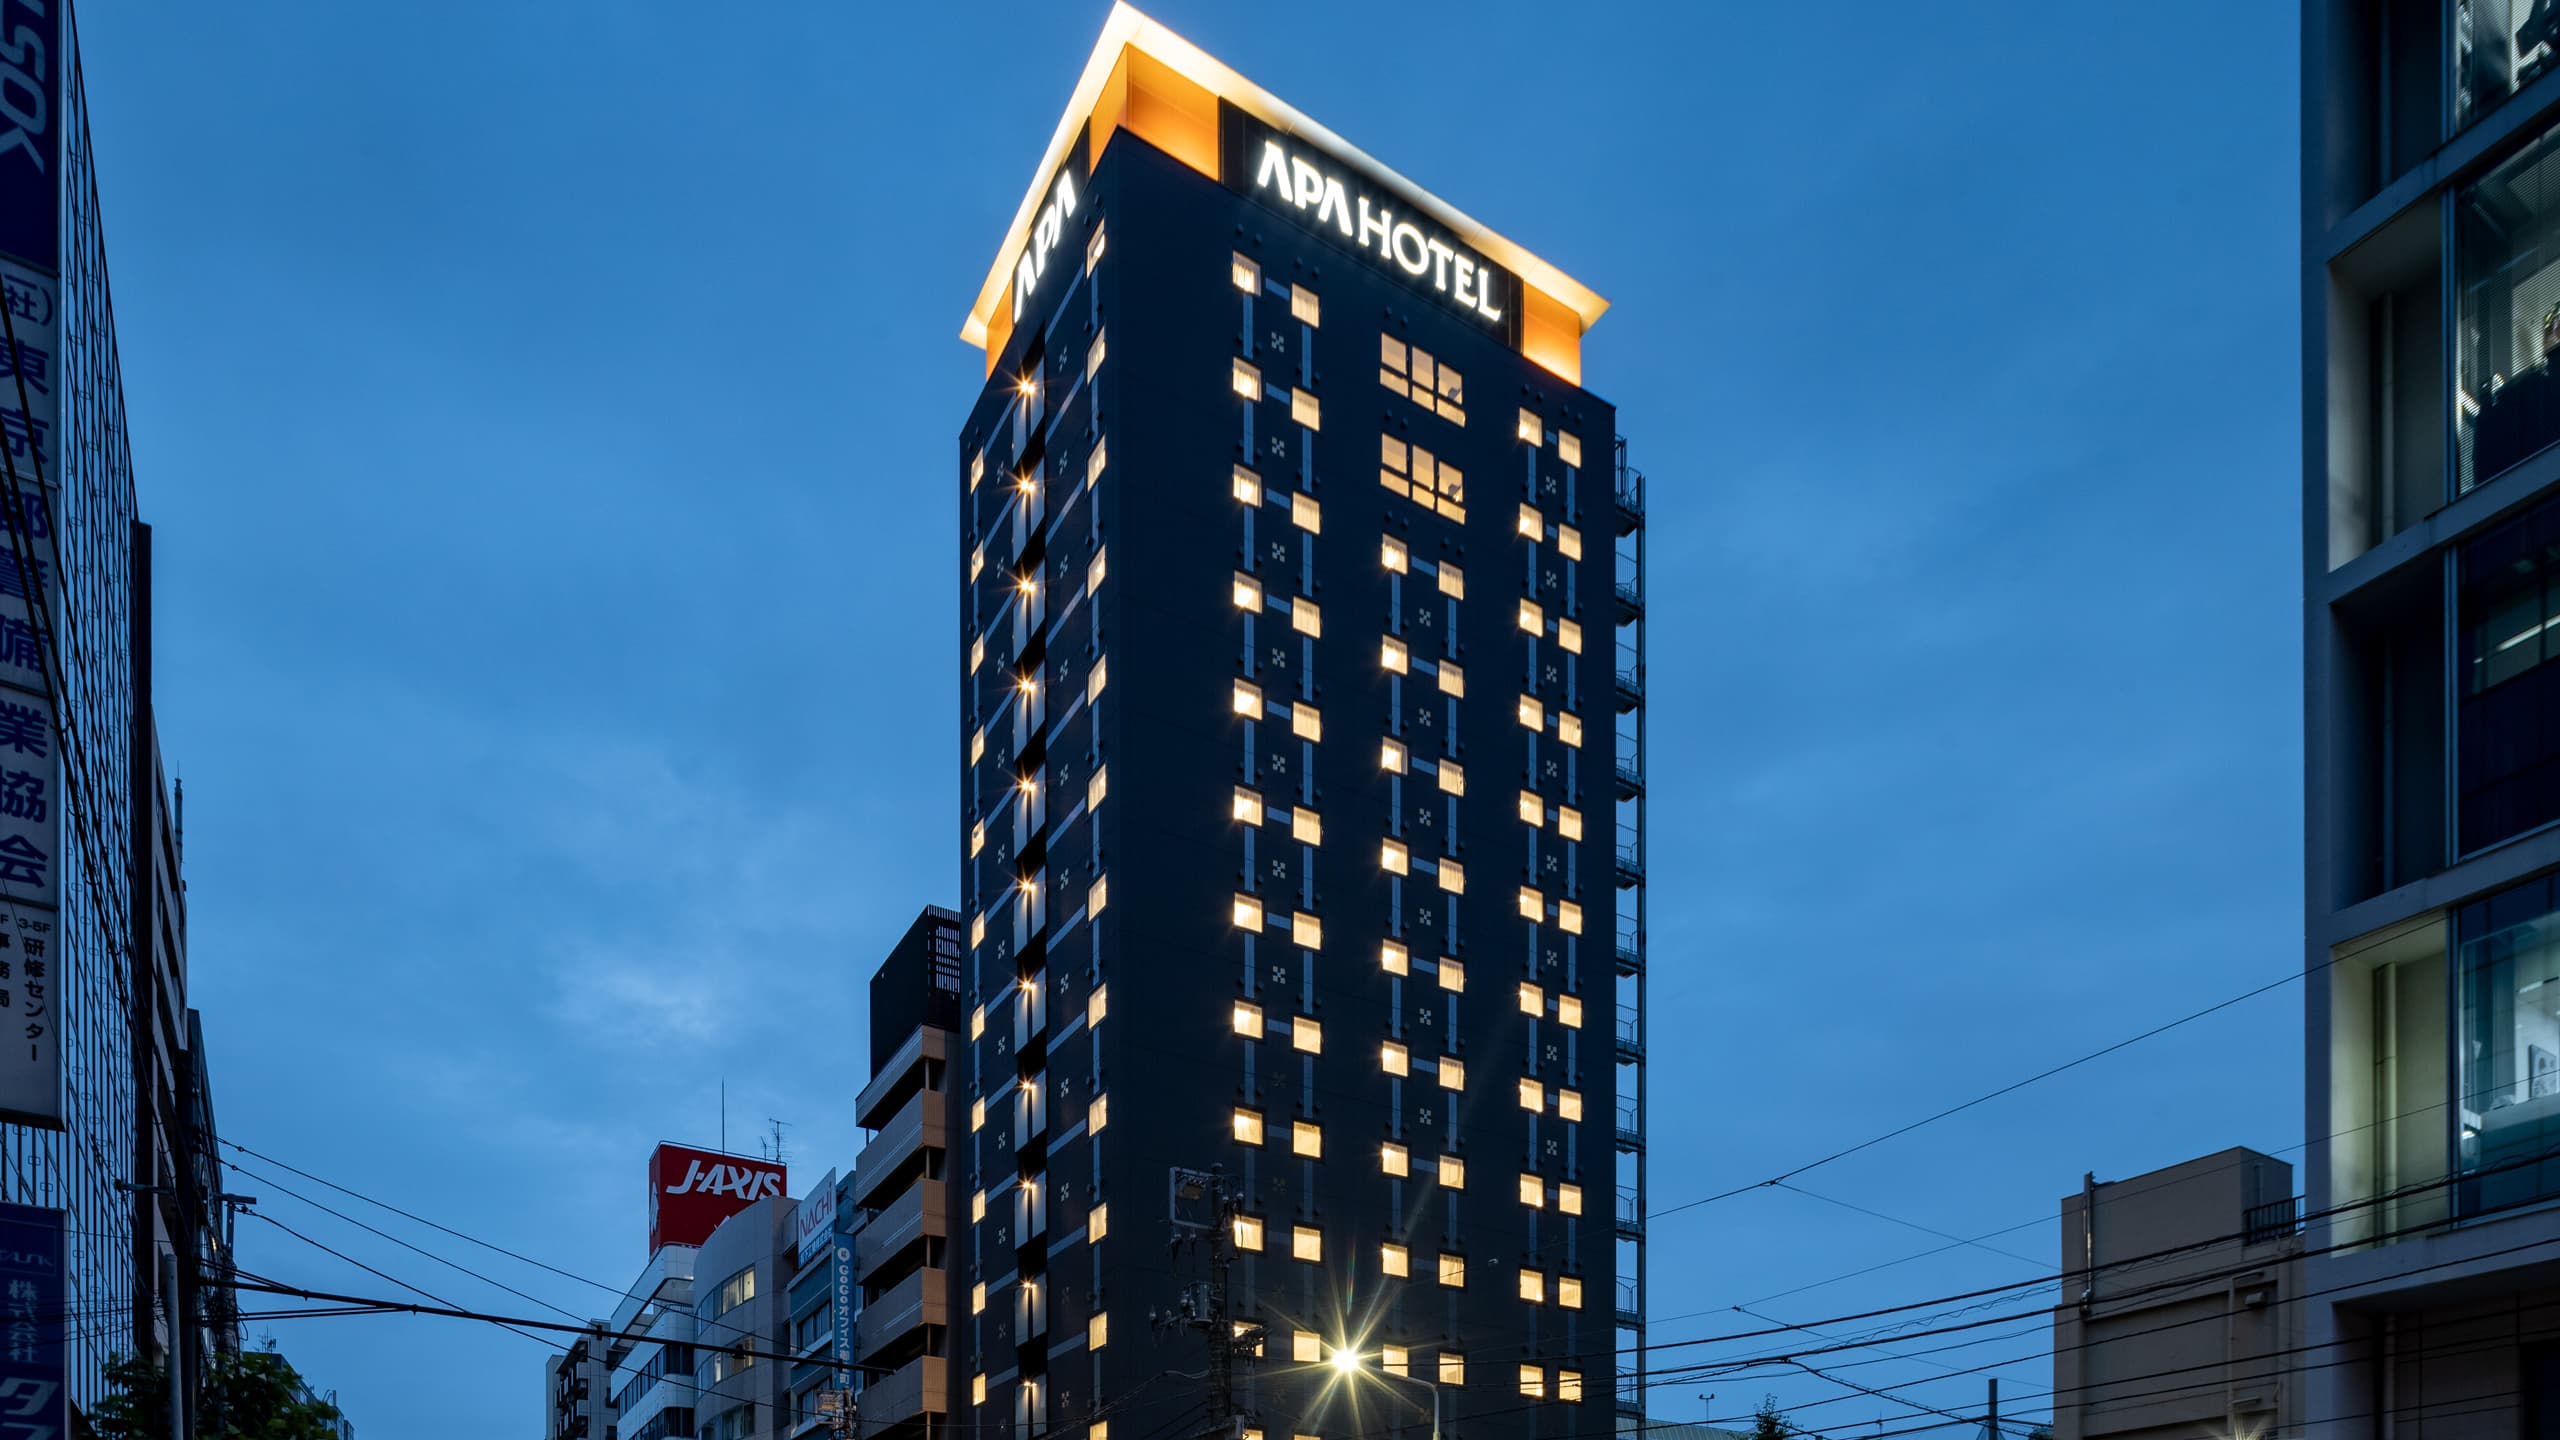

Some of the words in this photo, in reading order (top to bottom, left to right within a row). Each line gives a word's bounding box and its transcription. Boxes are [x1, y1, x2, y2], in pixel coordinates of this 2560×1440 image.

[1014, 169, 1077, 325] APA
[1257, 140, 1353, 237] APA
[1358, 196, 1502, 322] HOTEL
[18, 918, 51, 933] 3-5F
[24, 936, 45, 1061] 研修センター
[665, 1159, 781, 1201] J-AXIS
[8, 1279, 39, 1363] 株式会社
